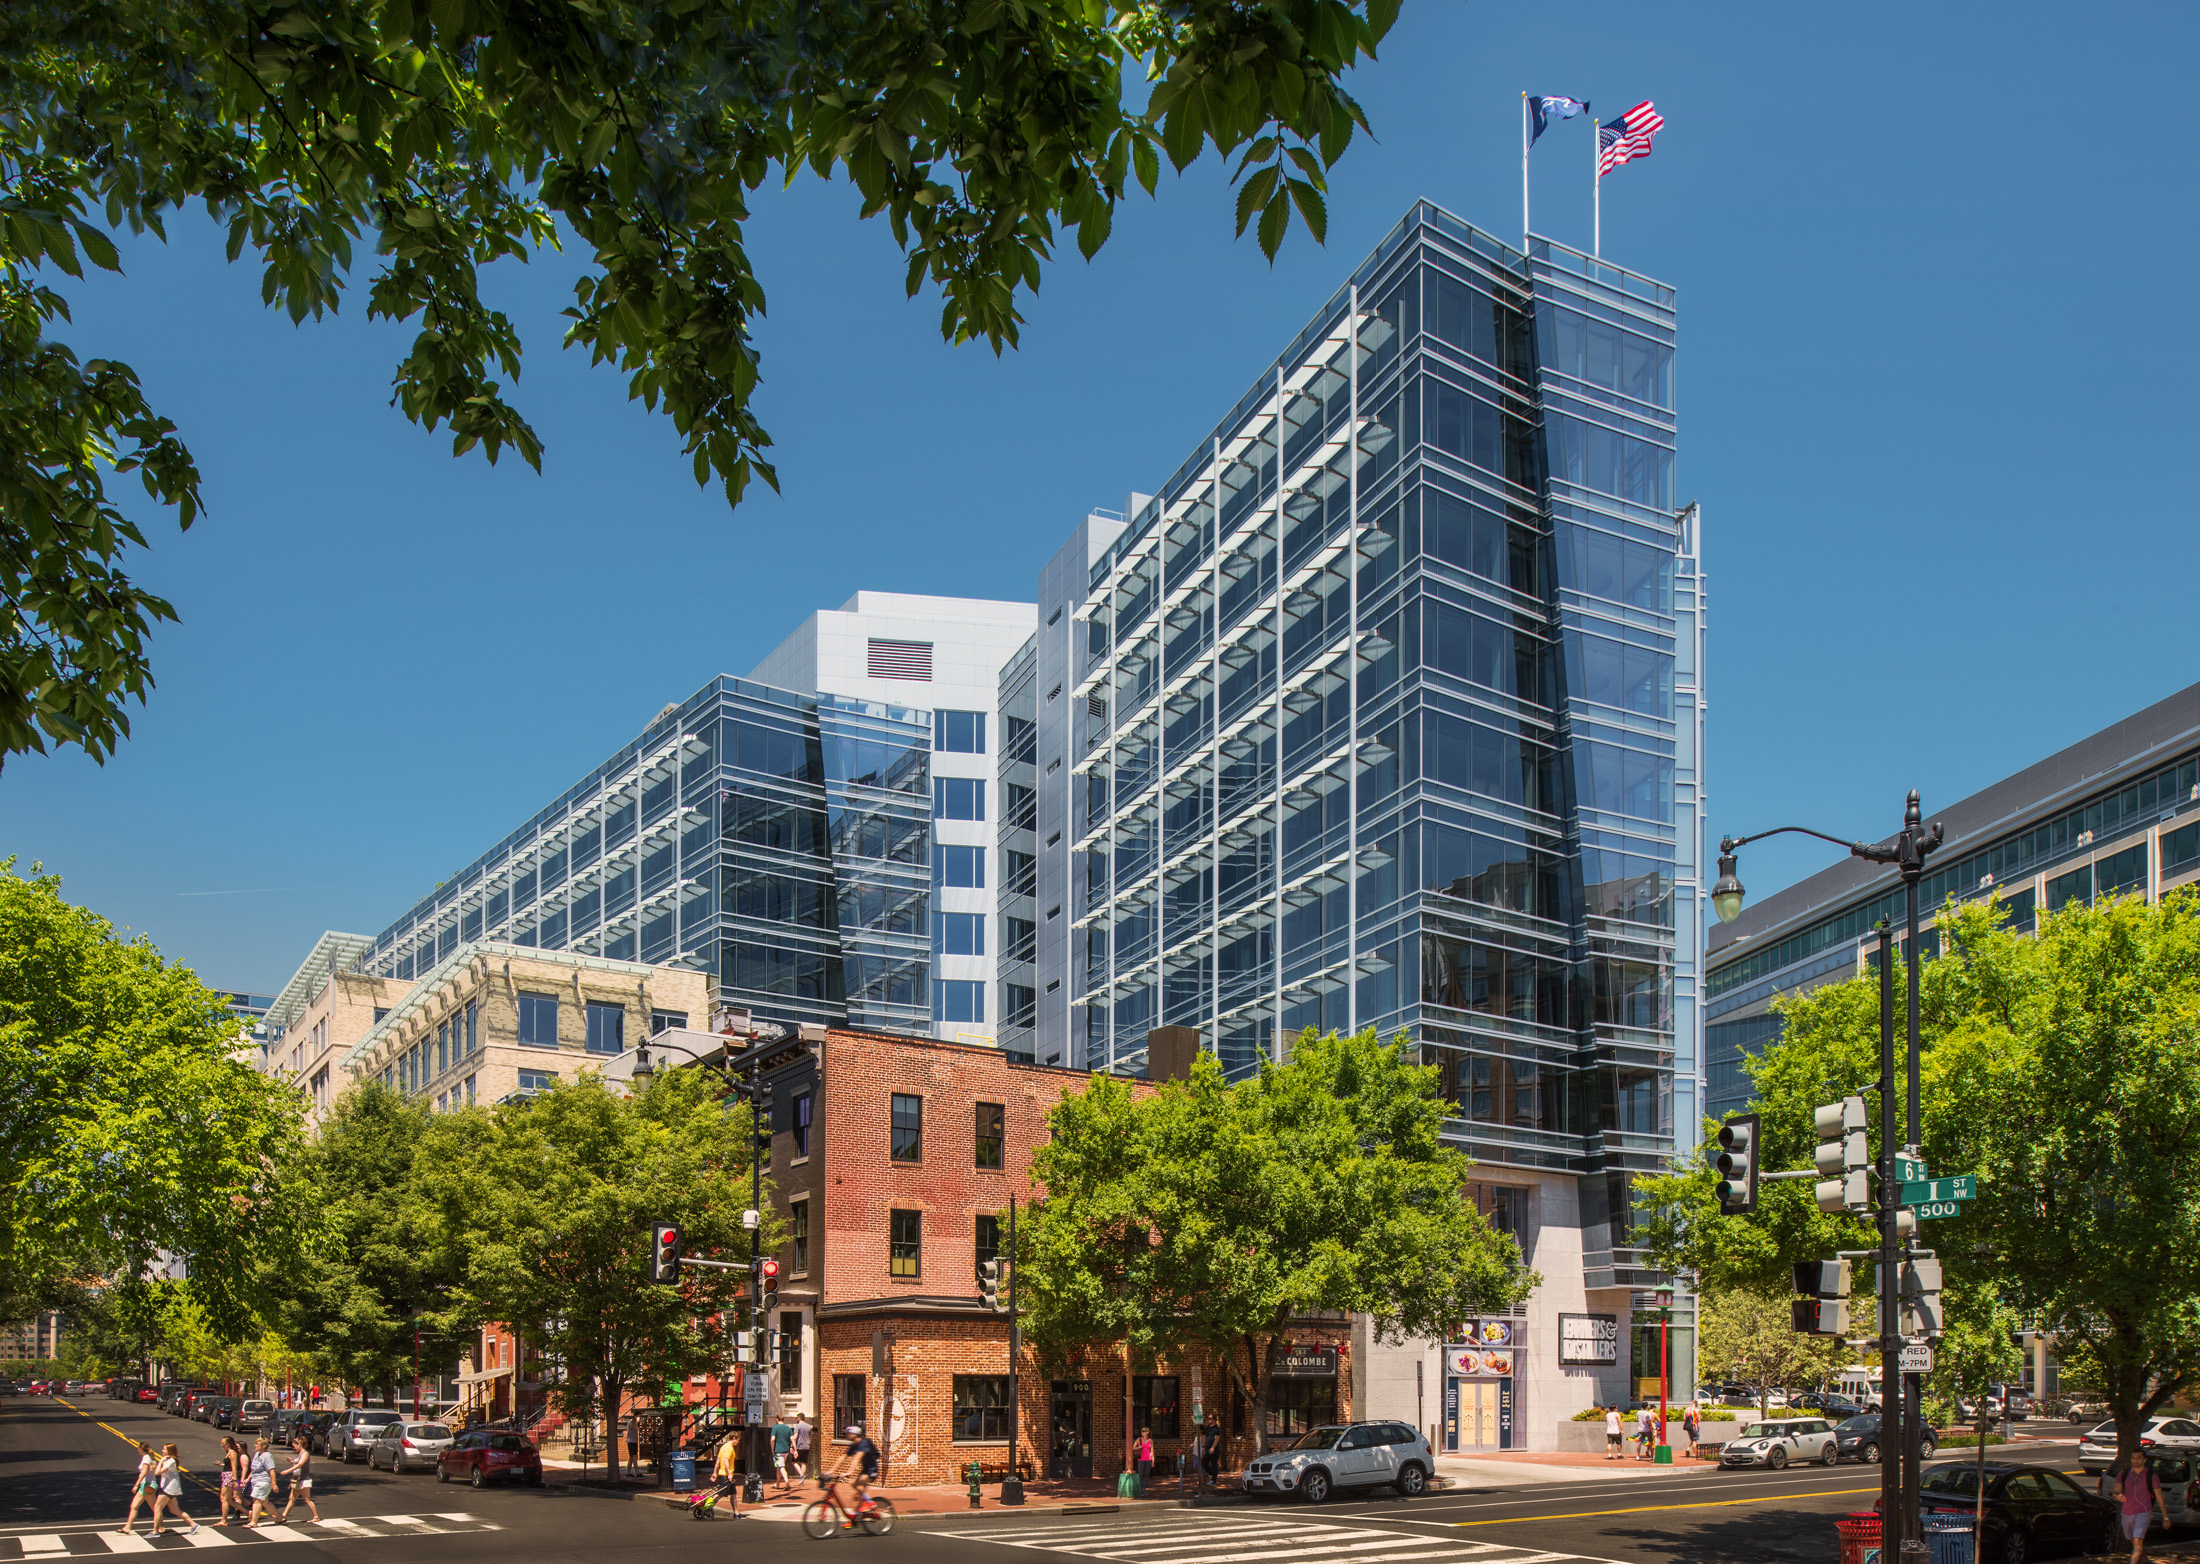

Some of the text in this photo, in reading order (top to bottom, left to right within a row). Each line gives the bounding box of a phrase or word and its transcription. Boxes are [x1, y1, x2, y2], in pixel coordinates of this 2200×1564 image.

[1905, 1162, 1924, 1180] 6 ST
[1929, 1179, 1966, 1200] I ST
[1954, 1189, 1967, 1198] NW
[1920, 1202, 1955, 1217] 500
[1906, 1347, 1927, 1355] RED
[1286, 1357, 1327, 1366] COLOMBE
[1073, 1383, 1089, 1391] 900
